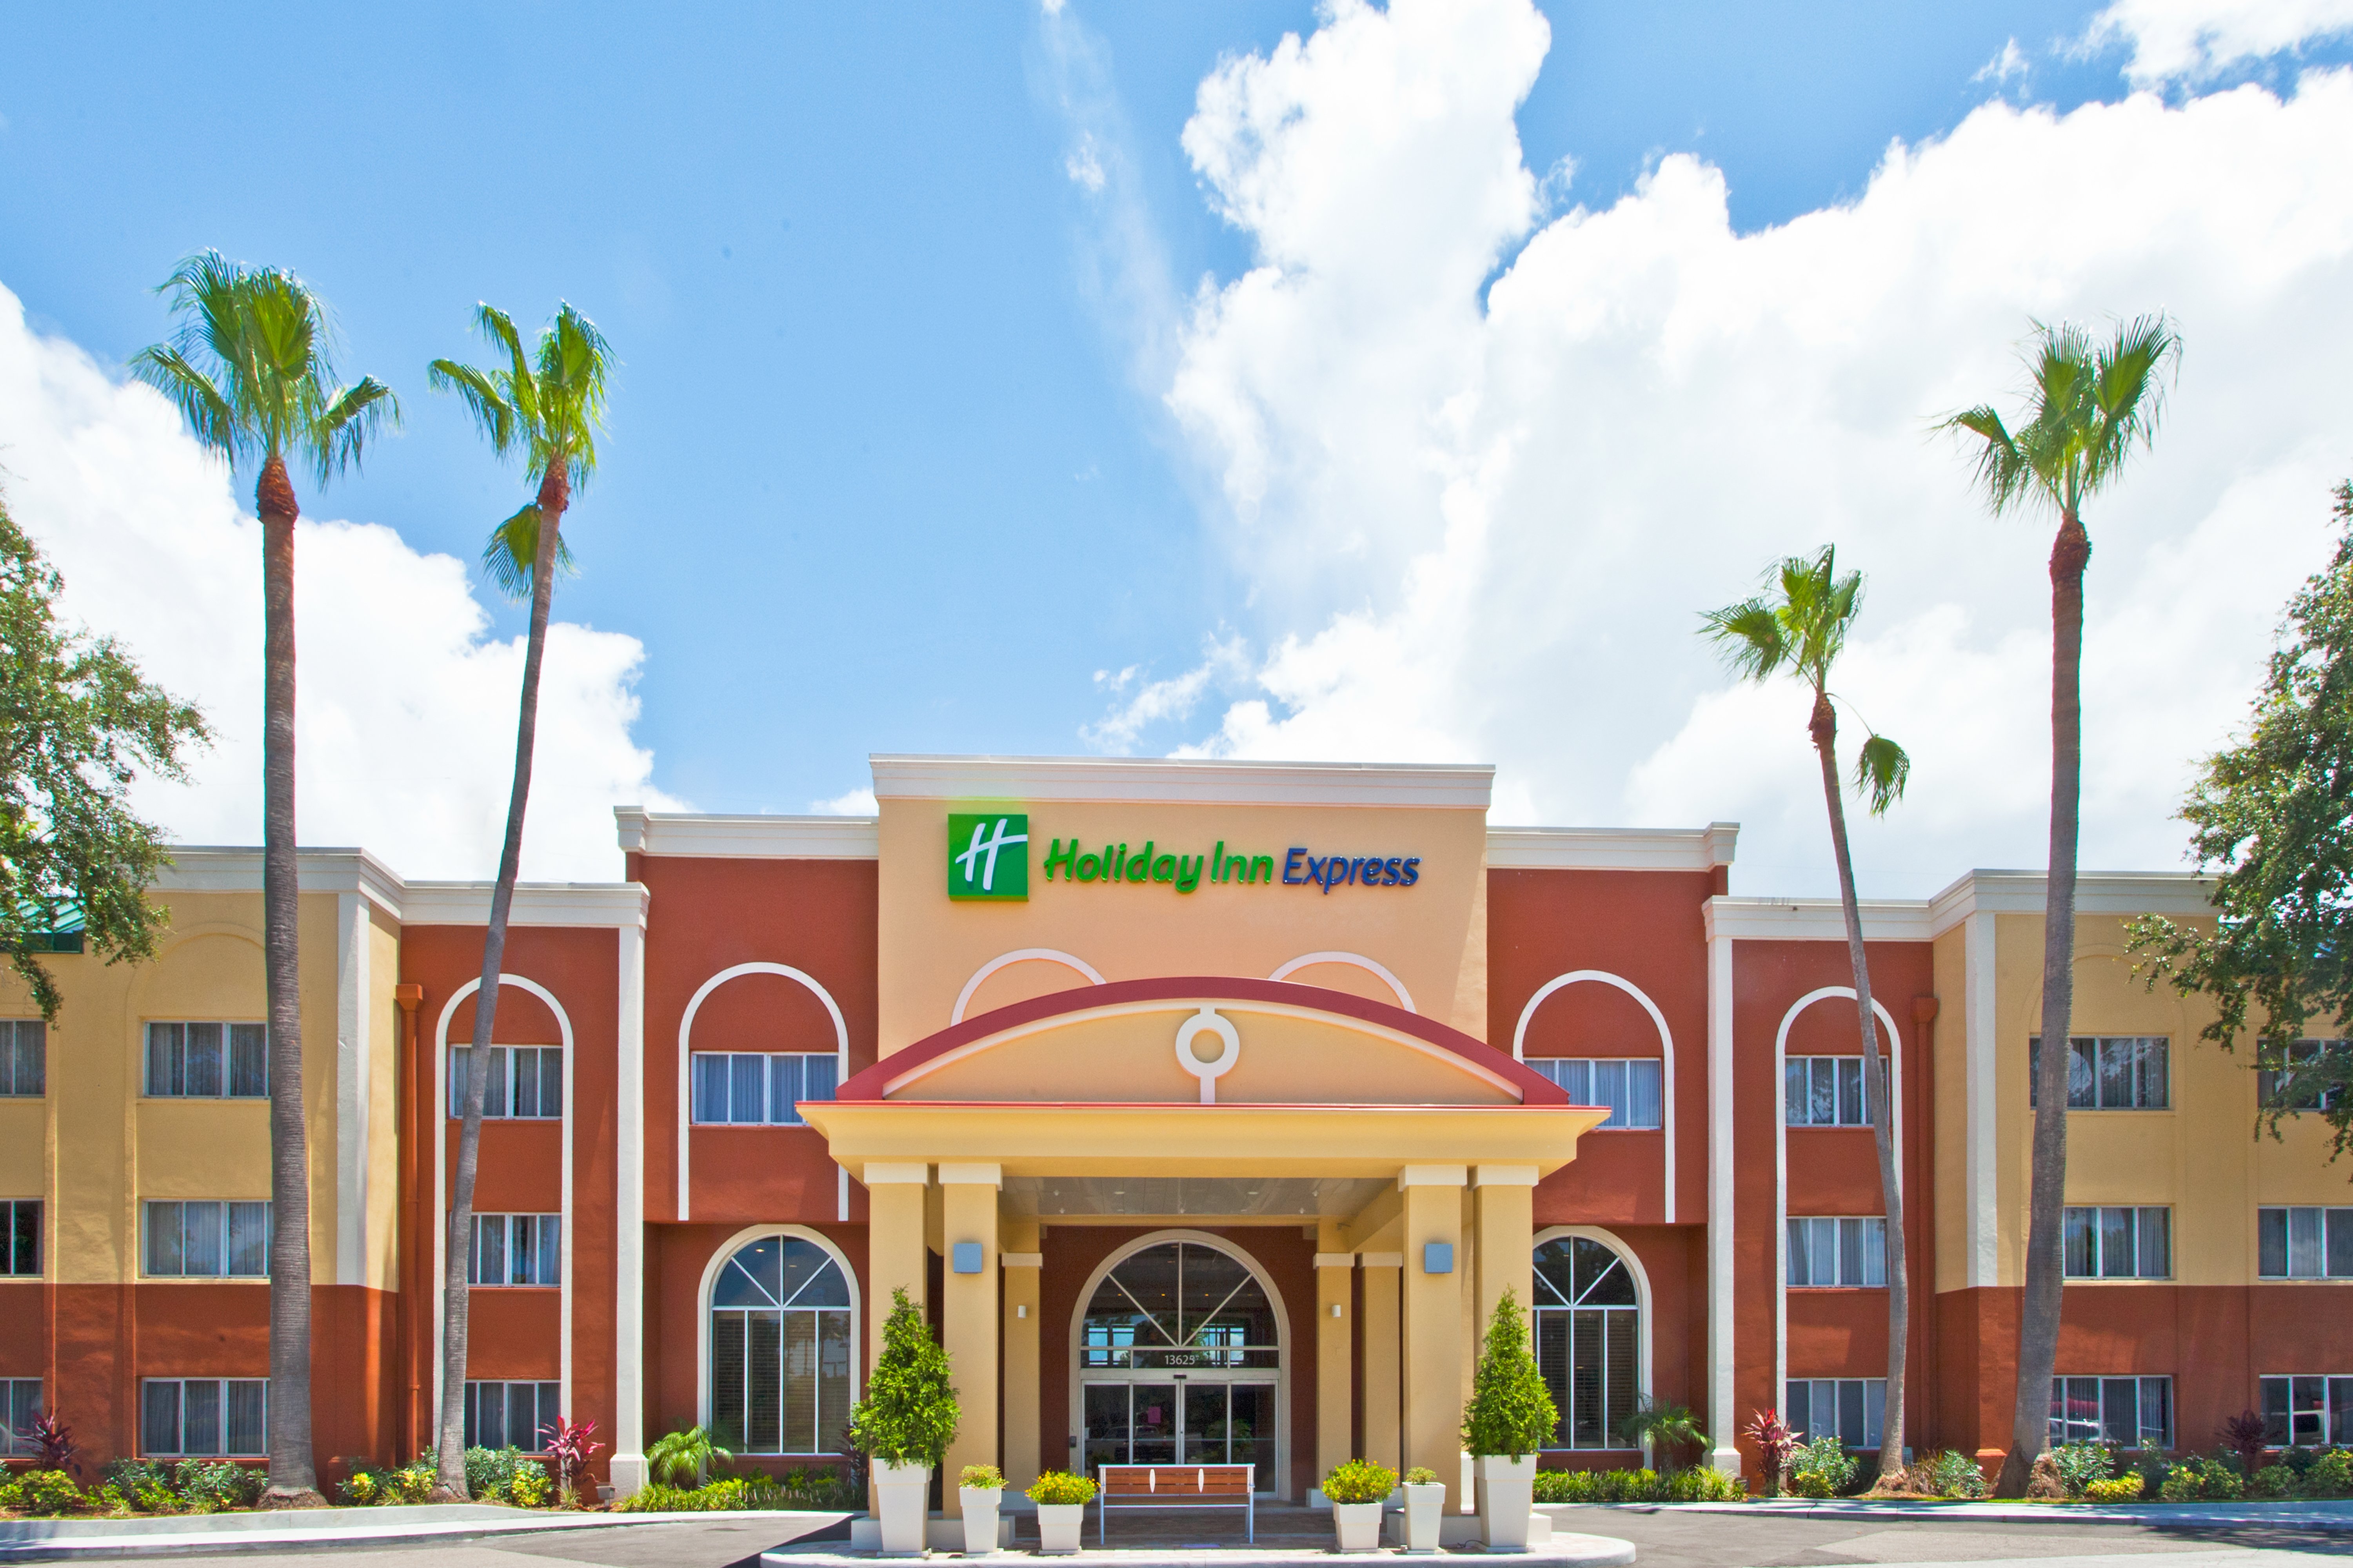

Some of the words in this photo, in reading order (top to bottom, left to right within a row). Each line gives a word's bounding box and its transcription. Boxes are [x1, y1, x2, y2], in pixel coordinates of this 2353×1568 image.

[955, 818, 1028, 890] H
[1043, 838, 1204, 893] Holiday
[1210, 841, 1274, 884] Inn
[1283, 848, 1421, 895] Express
[1165, 1355, 1195, 1365] 13625
